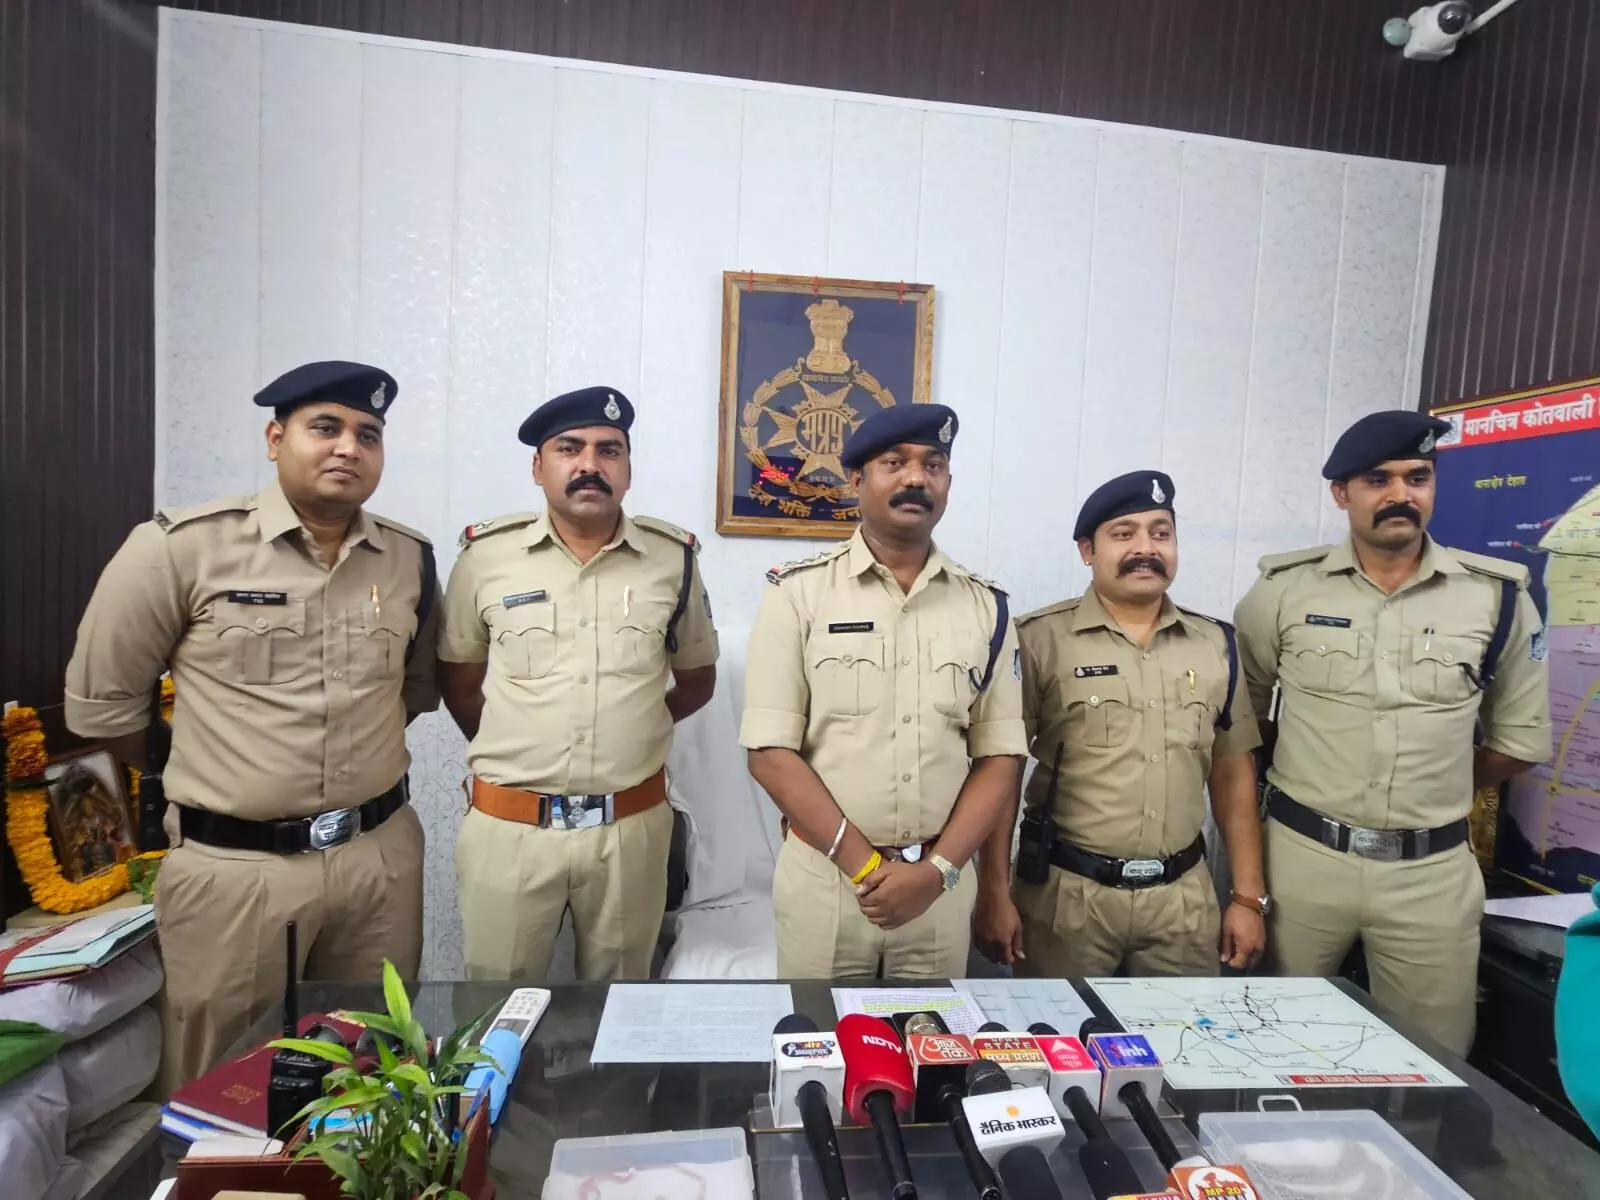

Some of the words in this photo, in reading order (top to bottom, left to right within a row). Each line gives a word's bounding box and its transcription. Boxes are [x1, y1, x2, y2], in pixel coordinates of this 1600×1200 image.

[1465, 410, 1520, 435] मानचित्र
[1523, 393, 1596, 426] कोतवाली
[862, 1035, 902, 1054] NDTV
[984, 1041, 1033, 1050] STATE
[979, 1119, 1015, 1136] दैनिक
[1016, 1115, 1057, 1129] भास्कर
